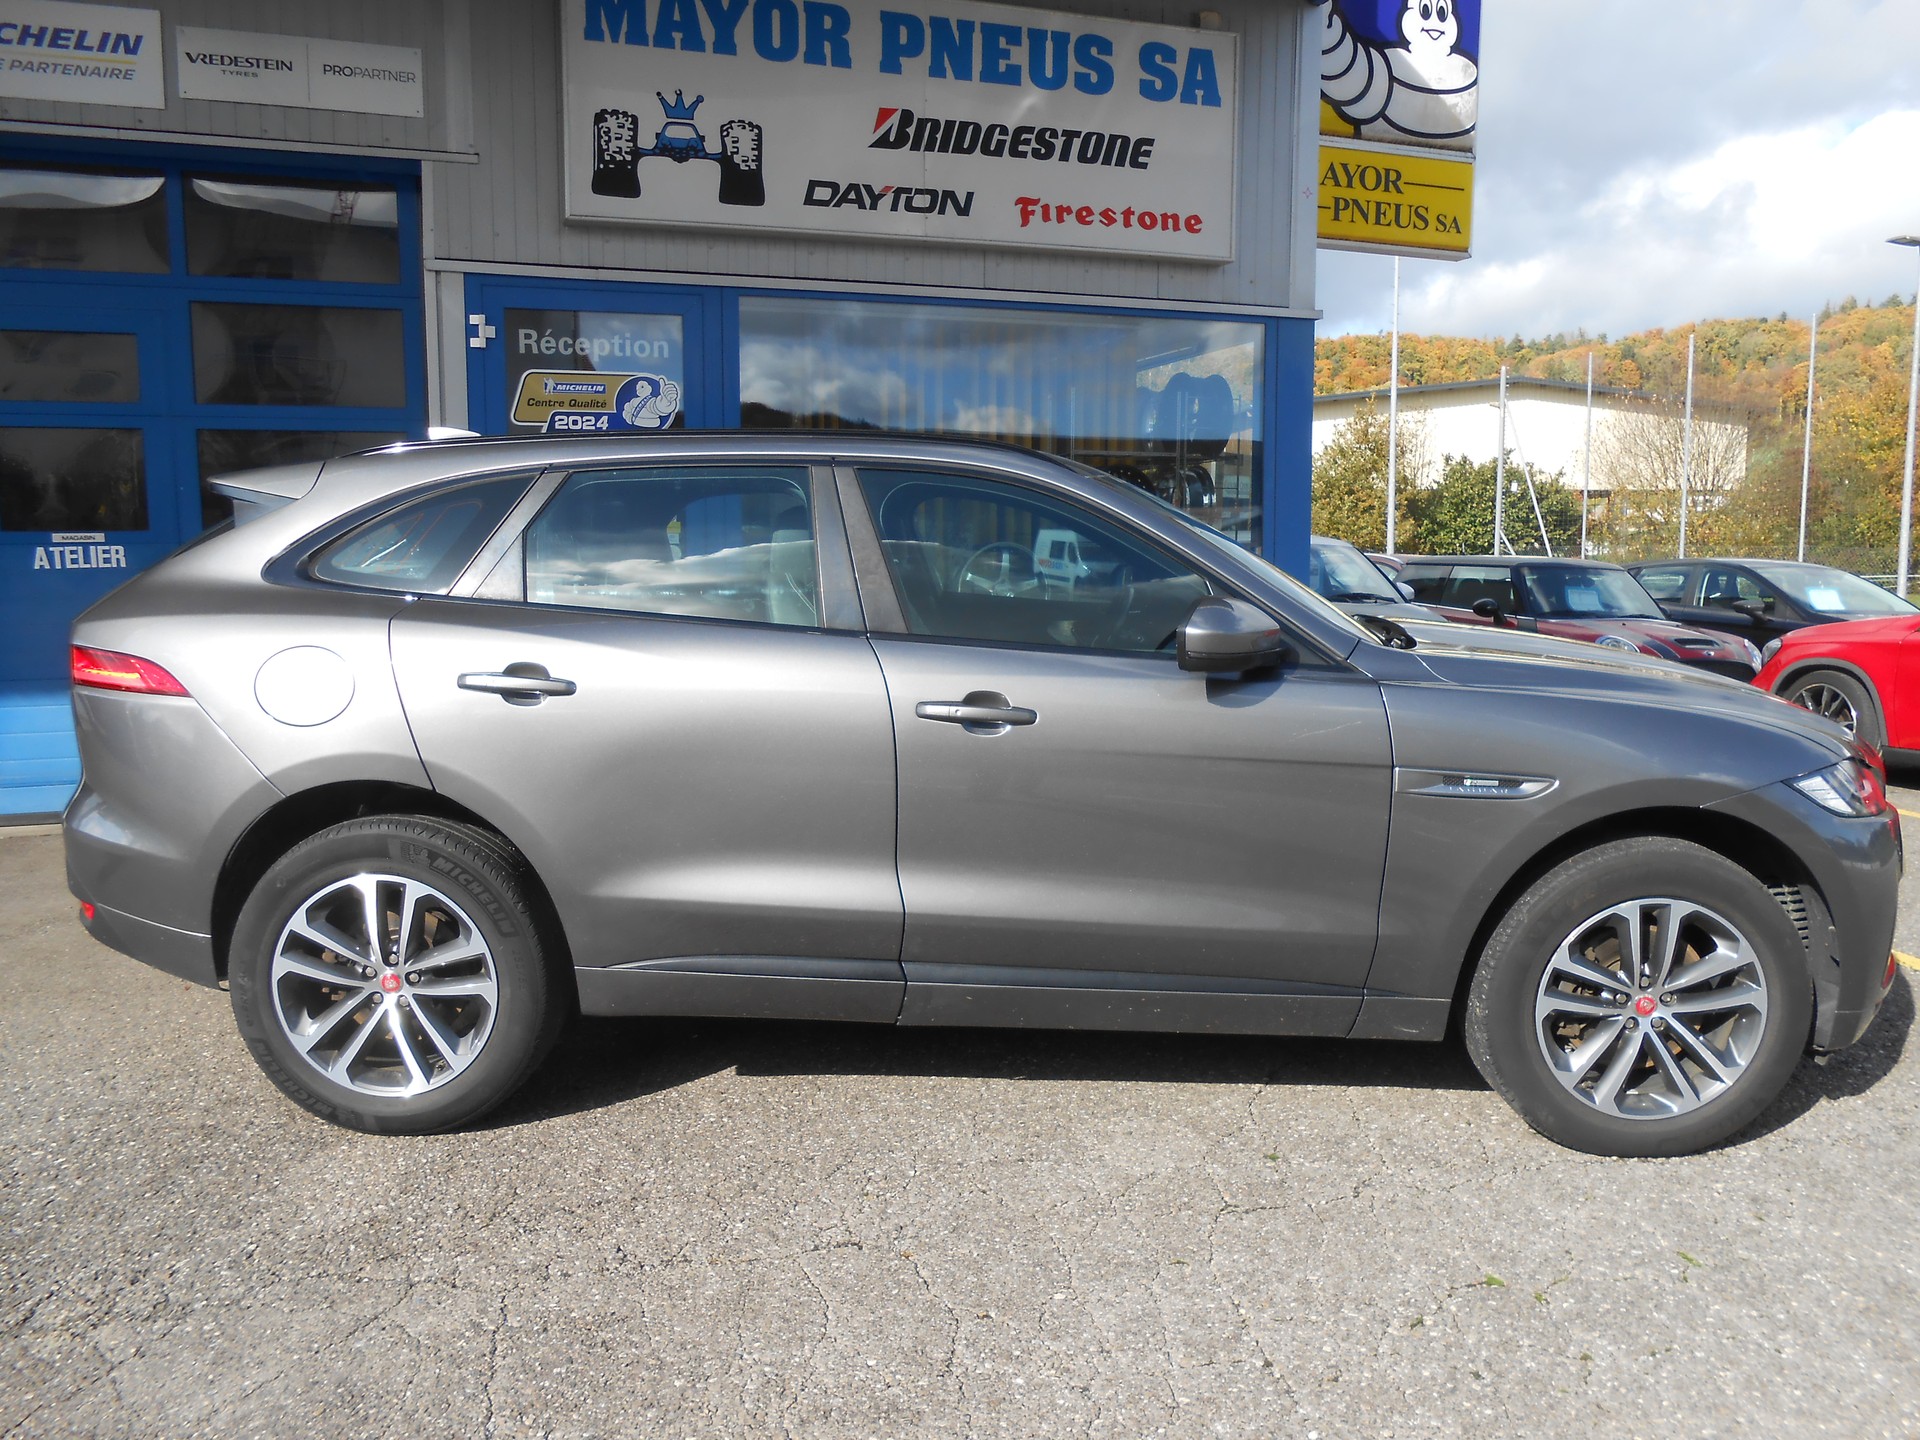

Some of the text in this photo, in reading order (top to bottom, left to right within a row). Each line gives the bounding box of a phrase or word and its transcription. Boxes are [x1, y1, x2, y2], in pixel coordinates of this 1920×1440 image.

[185, 52, 294, 72] VREDESTEIN
[584, 0, 1222, 108] MAYOR PNEUS SA
[9, 59, 136, 81] PARTENAIRE
[220, 69, 259, 78] TYRES
[322, 64, 416, 83] PROPARTNER
[803, 179, 975, 217] DAYTON
[1014, 196, 1203, 234] Firestone
[1332, 196, 1462, 235] PNEUS SA
[518, 328, 669, 362] Réception
[556, 384, 605, 393] MICHELIN
[527, 397, 607, 409] Centre Qualité
[554, 415, 609, 430] 2024
[34, 545, 127, 570] ATELIER
